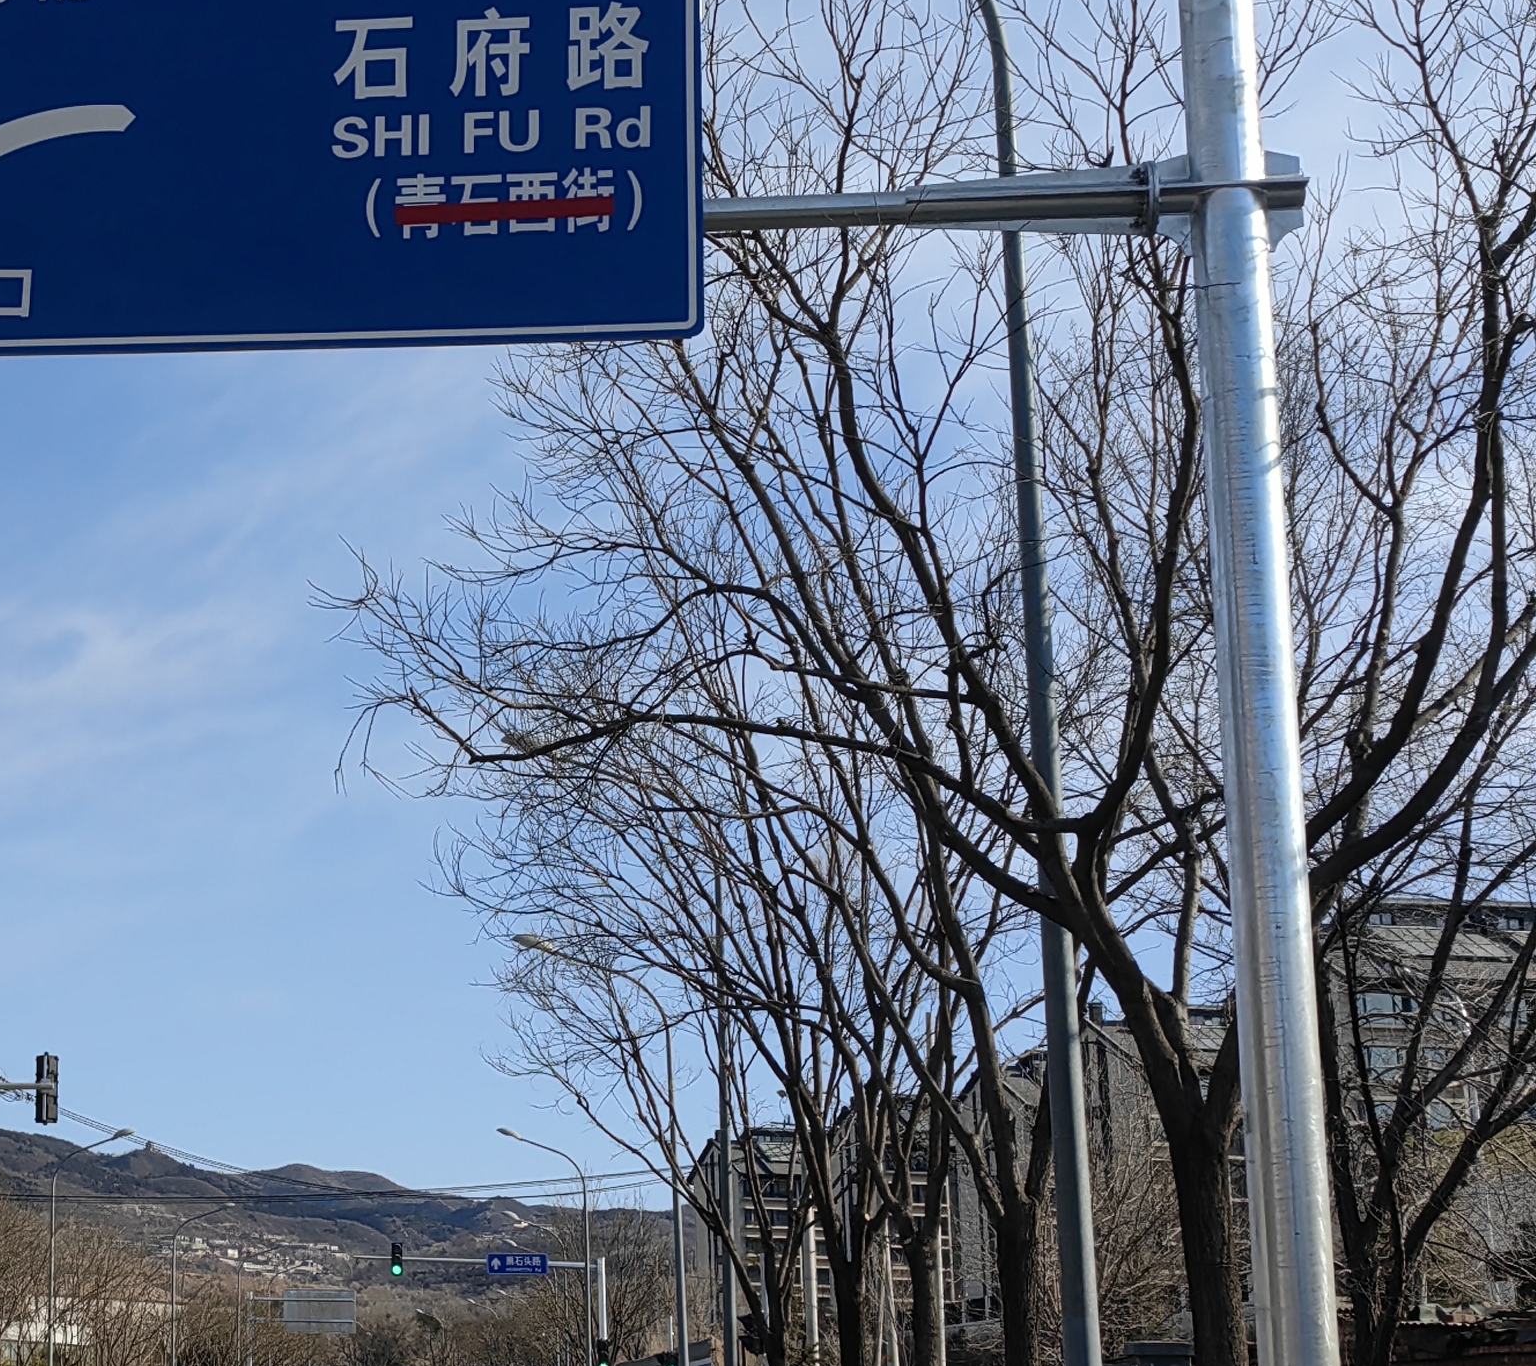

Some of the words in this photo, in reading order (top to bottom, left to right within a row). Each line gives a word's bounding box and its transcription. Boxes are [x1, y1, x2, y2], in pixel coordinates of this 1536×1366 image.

[334, 2, 649, 99] 石府路
[332, 113, 430, 159] SHI
[464, 110, 540, 154] FU
[576, 106, 651, 150] Rd
